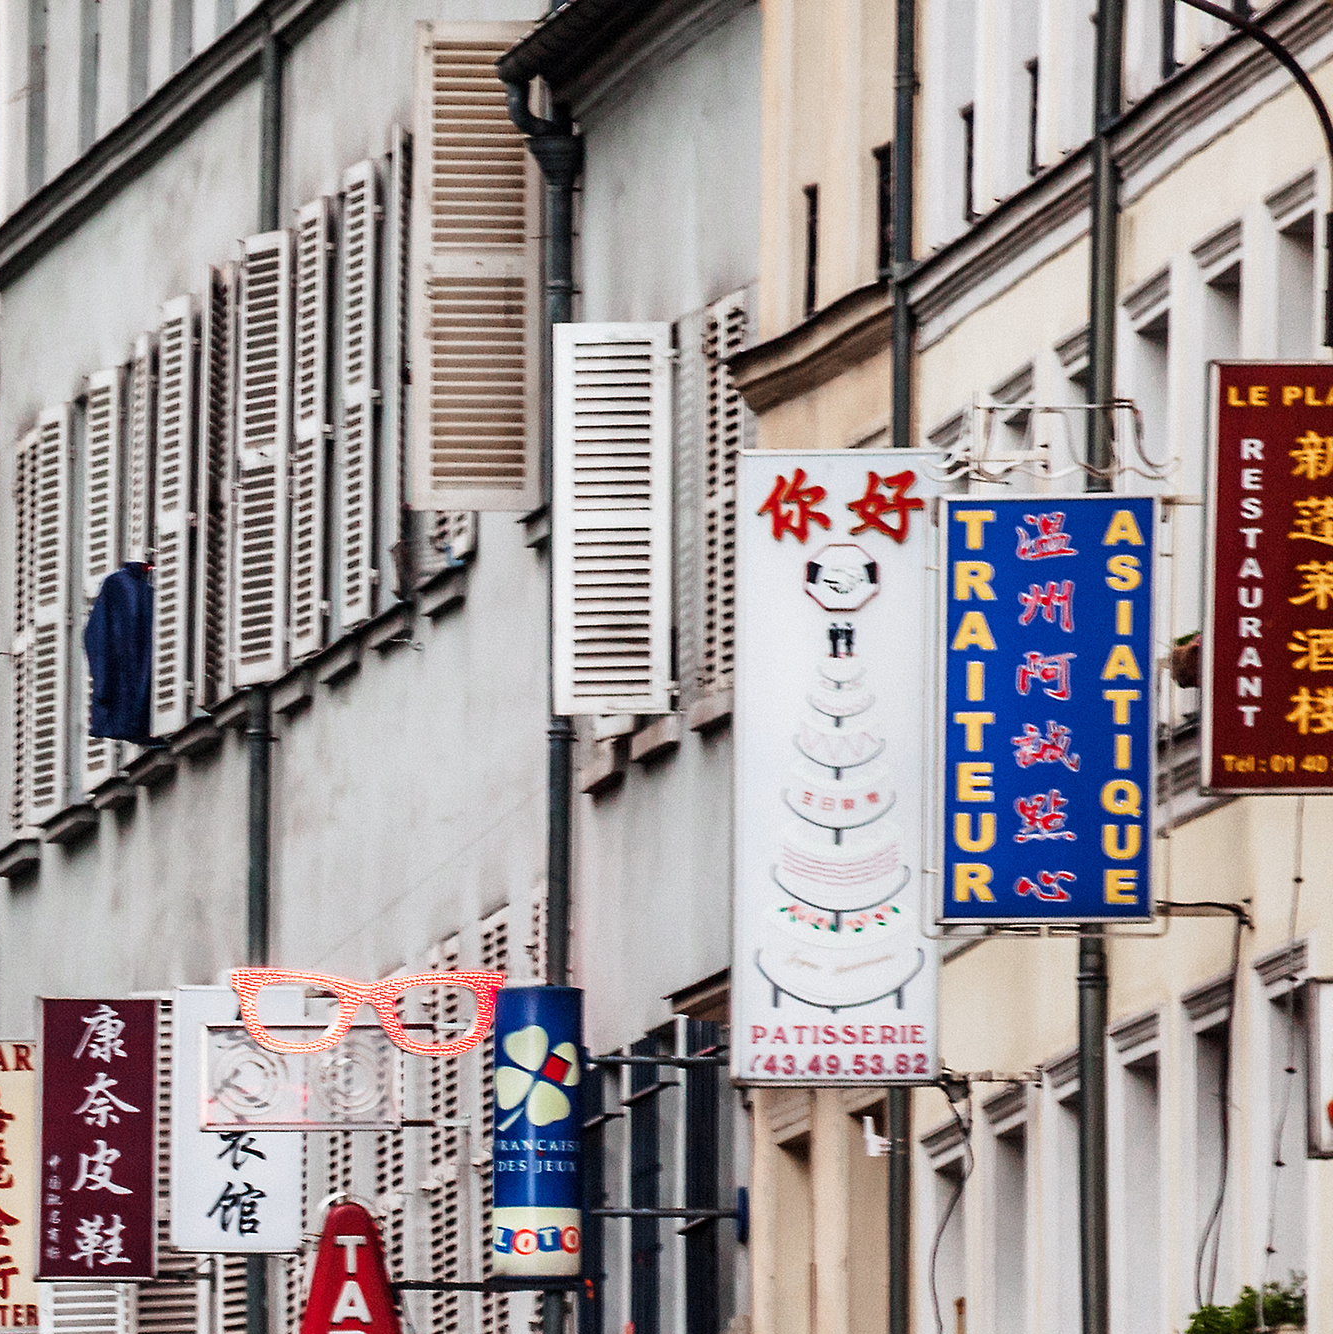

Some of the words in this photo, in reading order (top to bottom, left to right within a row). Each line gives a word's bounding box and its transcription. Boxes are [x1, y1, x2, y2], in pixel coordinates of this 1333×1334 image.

[1226, 386, 1269, 407] LE
[1282, 386, 1333, 407] PLA
[758, 468, 925, 544] 你好
[1238, 438, 1264, 728] RESTAURANT
[952, 509, 997, 902] TRAITEUR
[1100, 509, 1144, 905] ASIATIQUE
[750, 1025, 927, 1045] PATISSERIE
[70, 1003, 141, 1269] 康奈皮鞋
[497, 1160, 528, 1172] DES
[493, 1226, 582, 1255] LOTO
